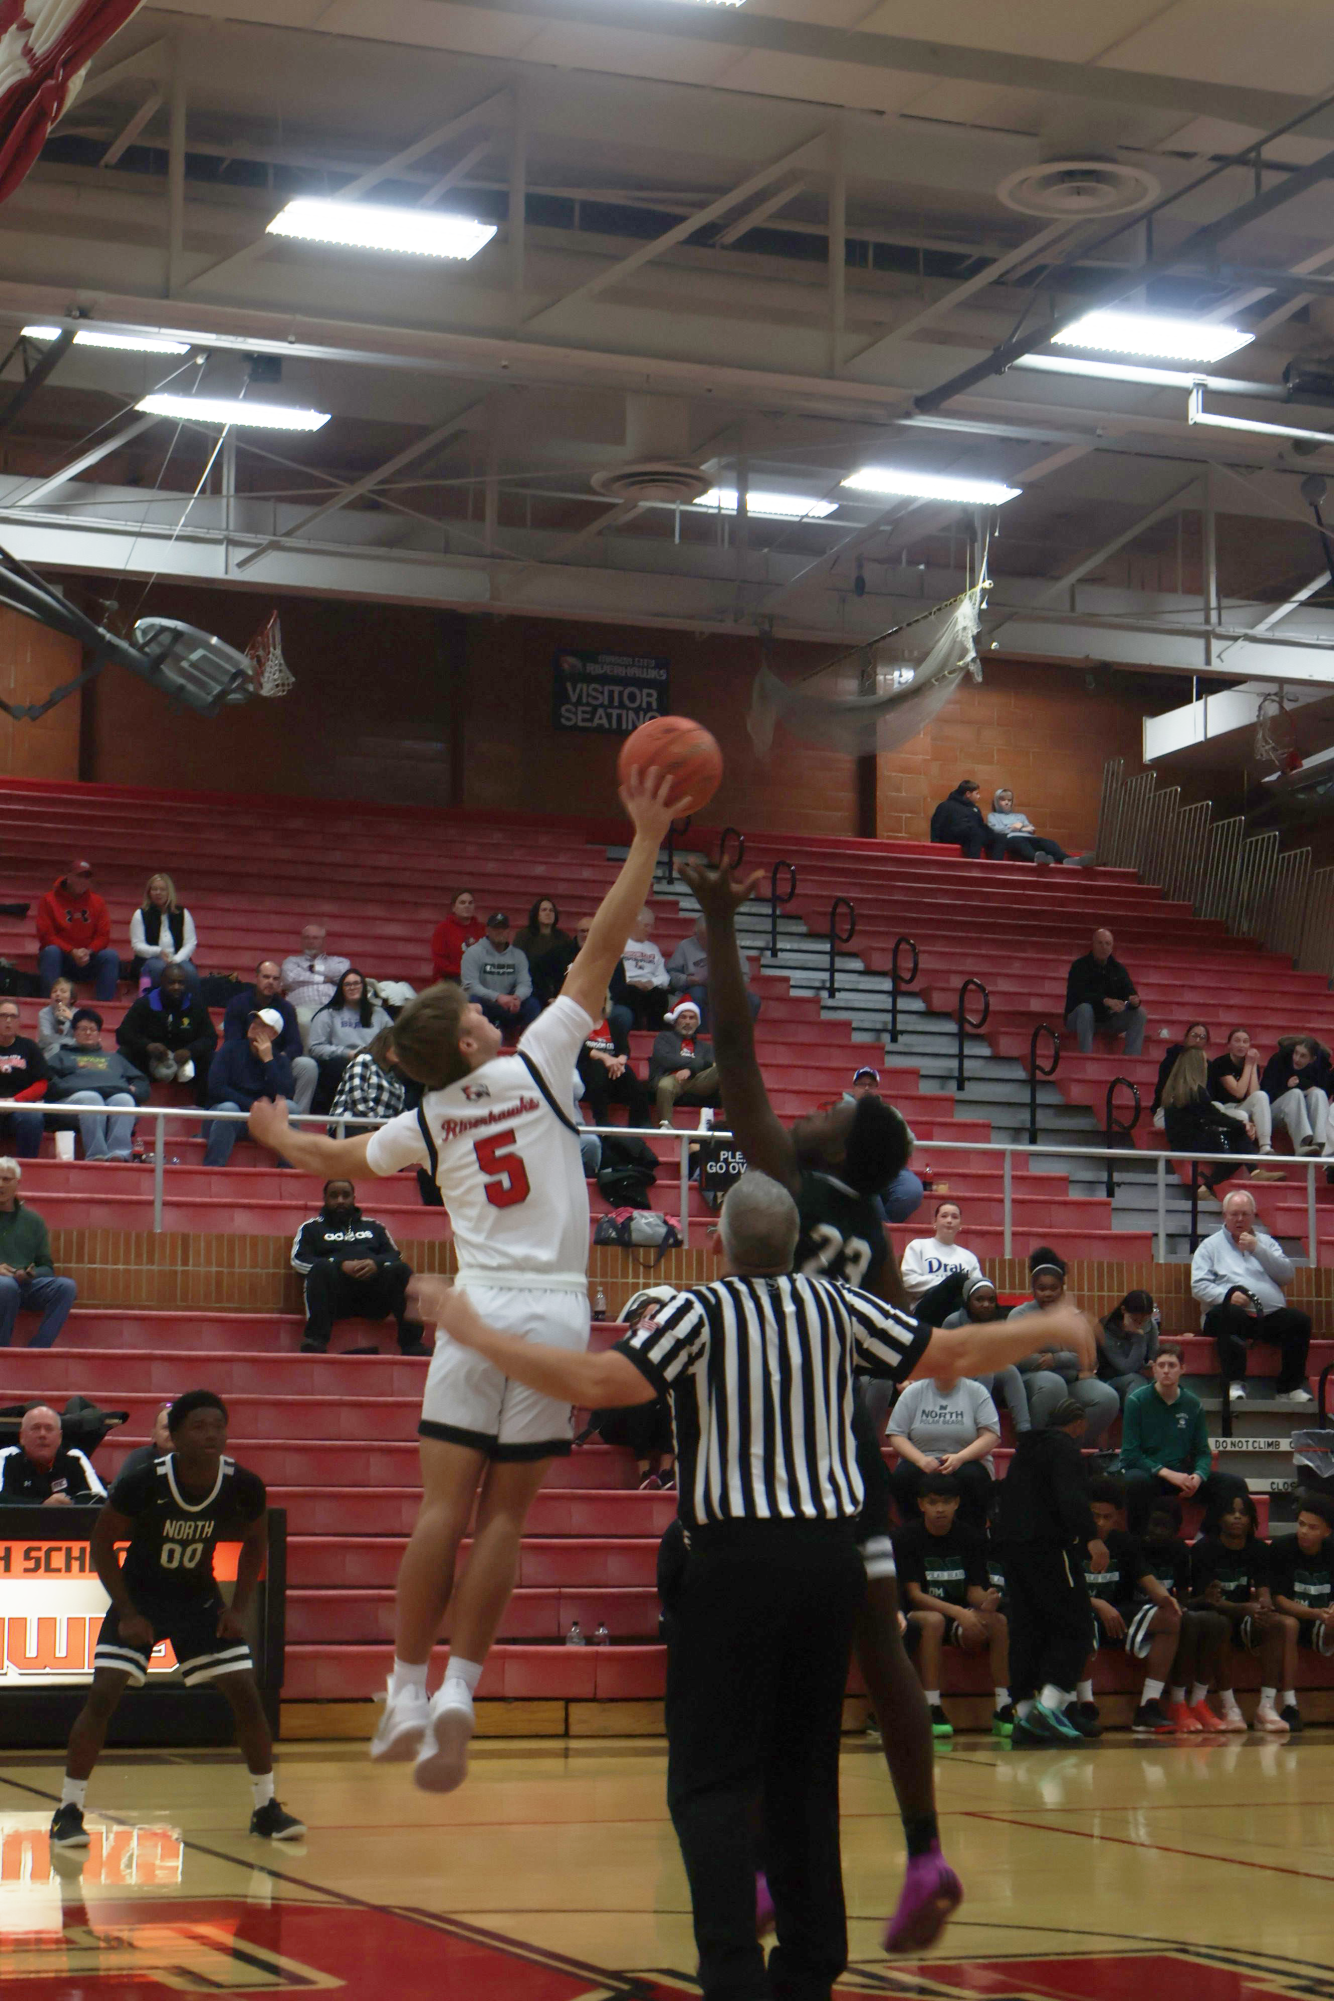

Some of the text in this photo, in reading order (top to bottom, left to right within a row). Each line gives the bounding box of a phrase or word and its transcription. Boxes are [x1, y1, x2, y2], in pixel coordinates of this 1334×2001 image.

[566, 682, 658, 709] VISITOR
[441, 1094, 540, 1142] Riverhawks
[720, 1150, 747, 1162] PLE
[473, 1128, 530, 1208] 5
[707, 1162, 727, 1173] GO
[920, 1409, 964, 1419] NORTH
[1214, 1440, 1229, 1450] DO
[1230, 1440, 1250, 1450] NOT
[1251, 1440, 1281, 1450] CLIMB
[162, 1519, 215, 1540] NORTH
[160, 1542, 204, 1570] 00
